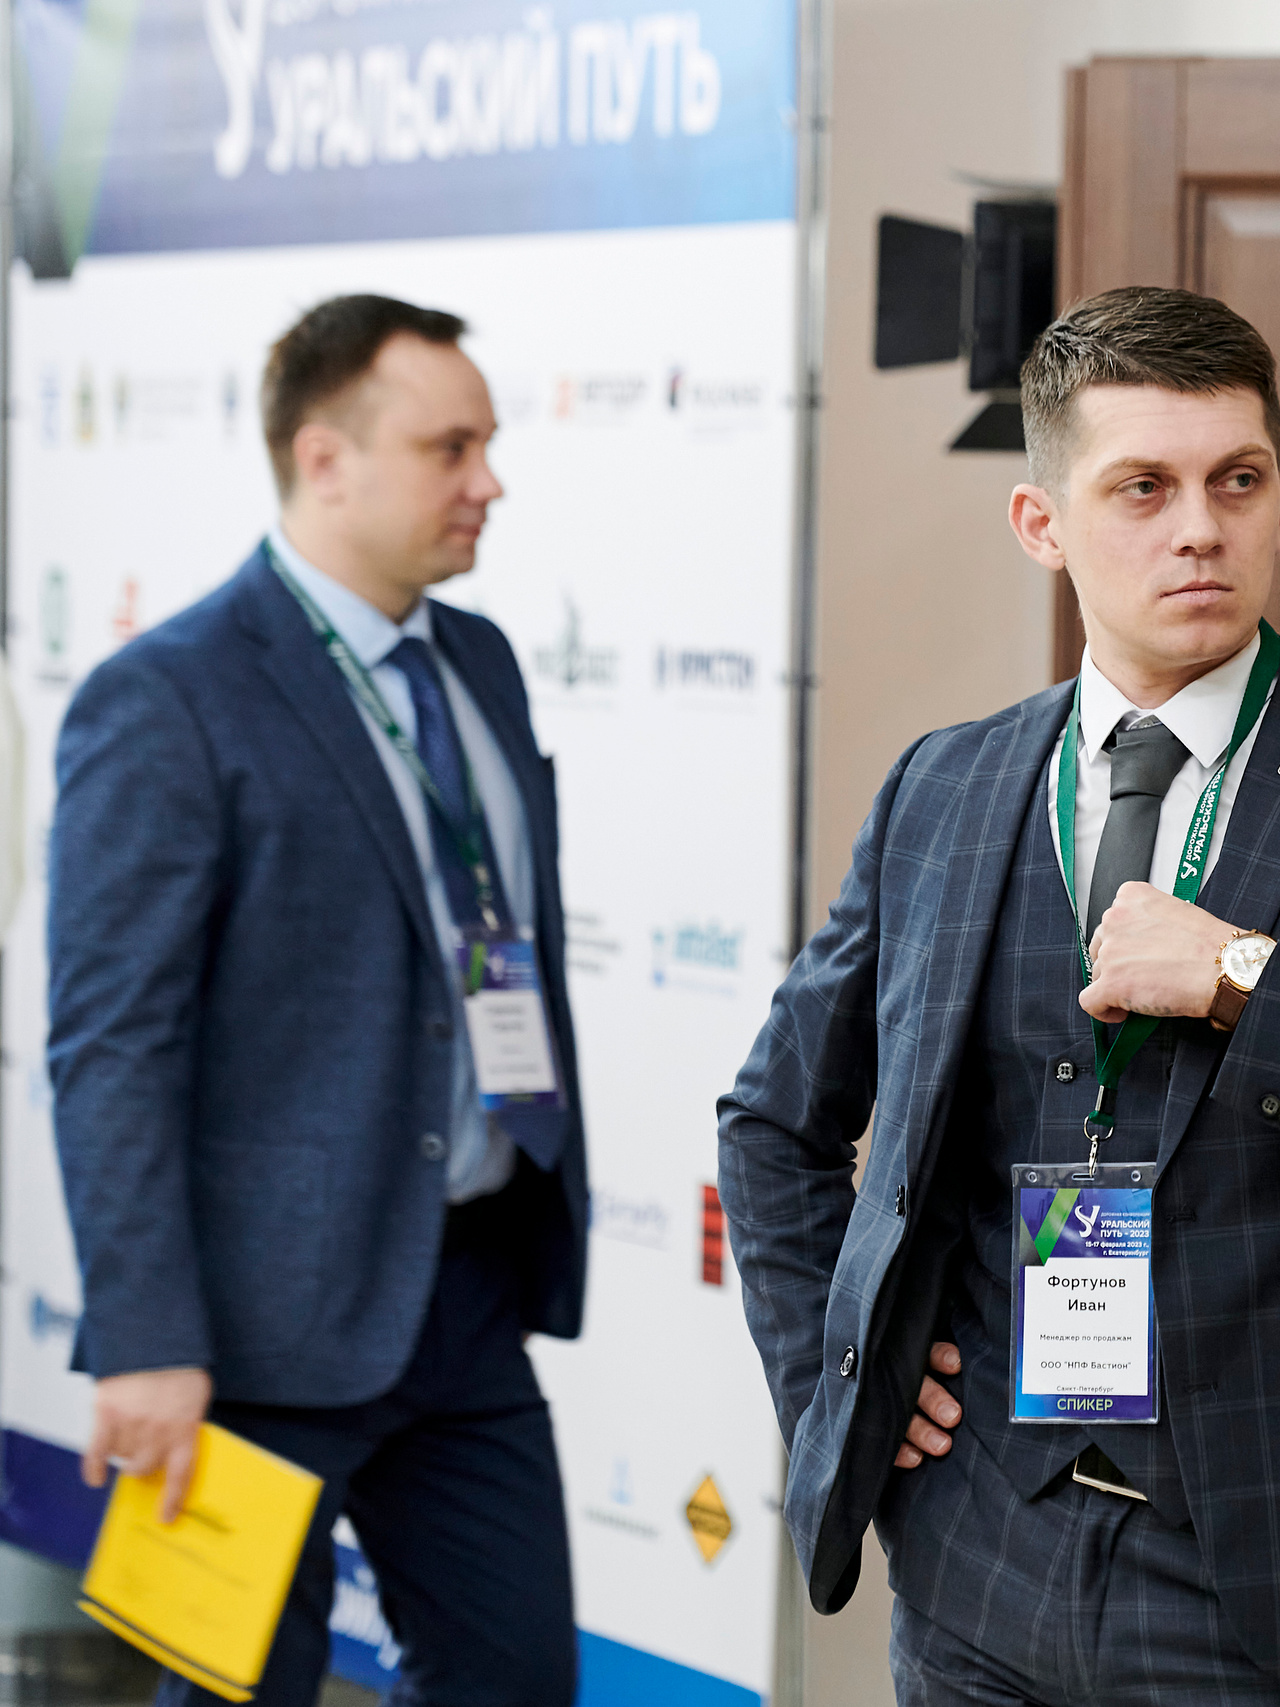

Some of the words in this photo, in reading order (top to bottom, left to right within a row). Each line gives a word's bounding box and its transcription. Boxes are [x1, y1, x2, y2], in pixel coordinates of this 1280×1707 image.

[264, 6, 559, 175] УРАЛЬСКИЙ
[567, 10, 722, 146] ПУТЬ
[1192, 791, 1216, 862] УРАЛЬСКИЙ
[1185, 817, 1202, 861] ДОРОЖНАЯ
[1100, 1219, 1150, 1229] УРАЛЬСКИЙ
[1100, 1229, 1123, 1238] ПУТЬ
[1129, 1229, 1150, 1238] 2023
[1108, 1249, 1149, 1257] Екатеринбург
[1047, 1275, 1127, 1291] Фортунов
[1068, 1299, 1106, 1311] Иван
[1039, 1334, 1080, 1342] Менеджер
[1040, 1361, 1062, 1369] ООО
[1091, 1361, 1132, 1370] Бастион"
[1056, 1385, 1114, 1393] Санкт-Петербург
[1056, 1398, 1113, 1411] СПИКЕР
